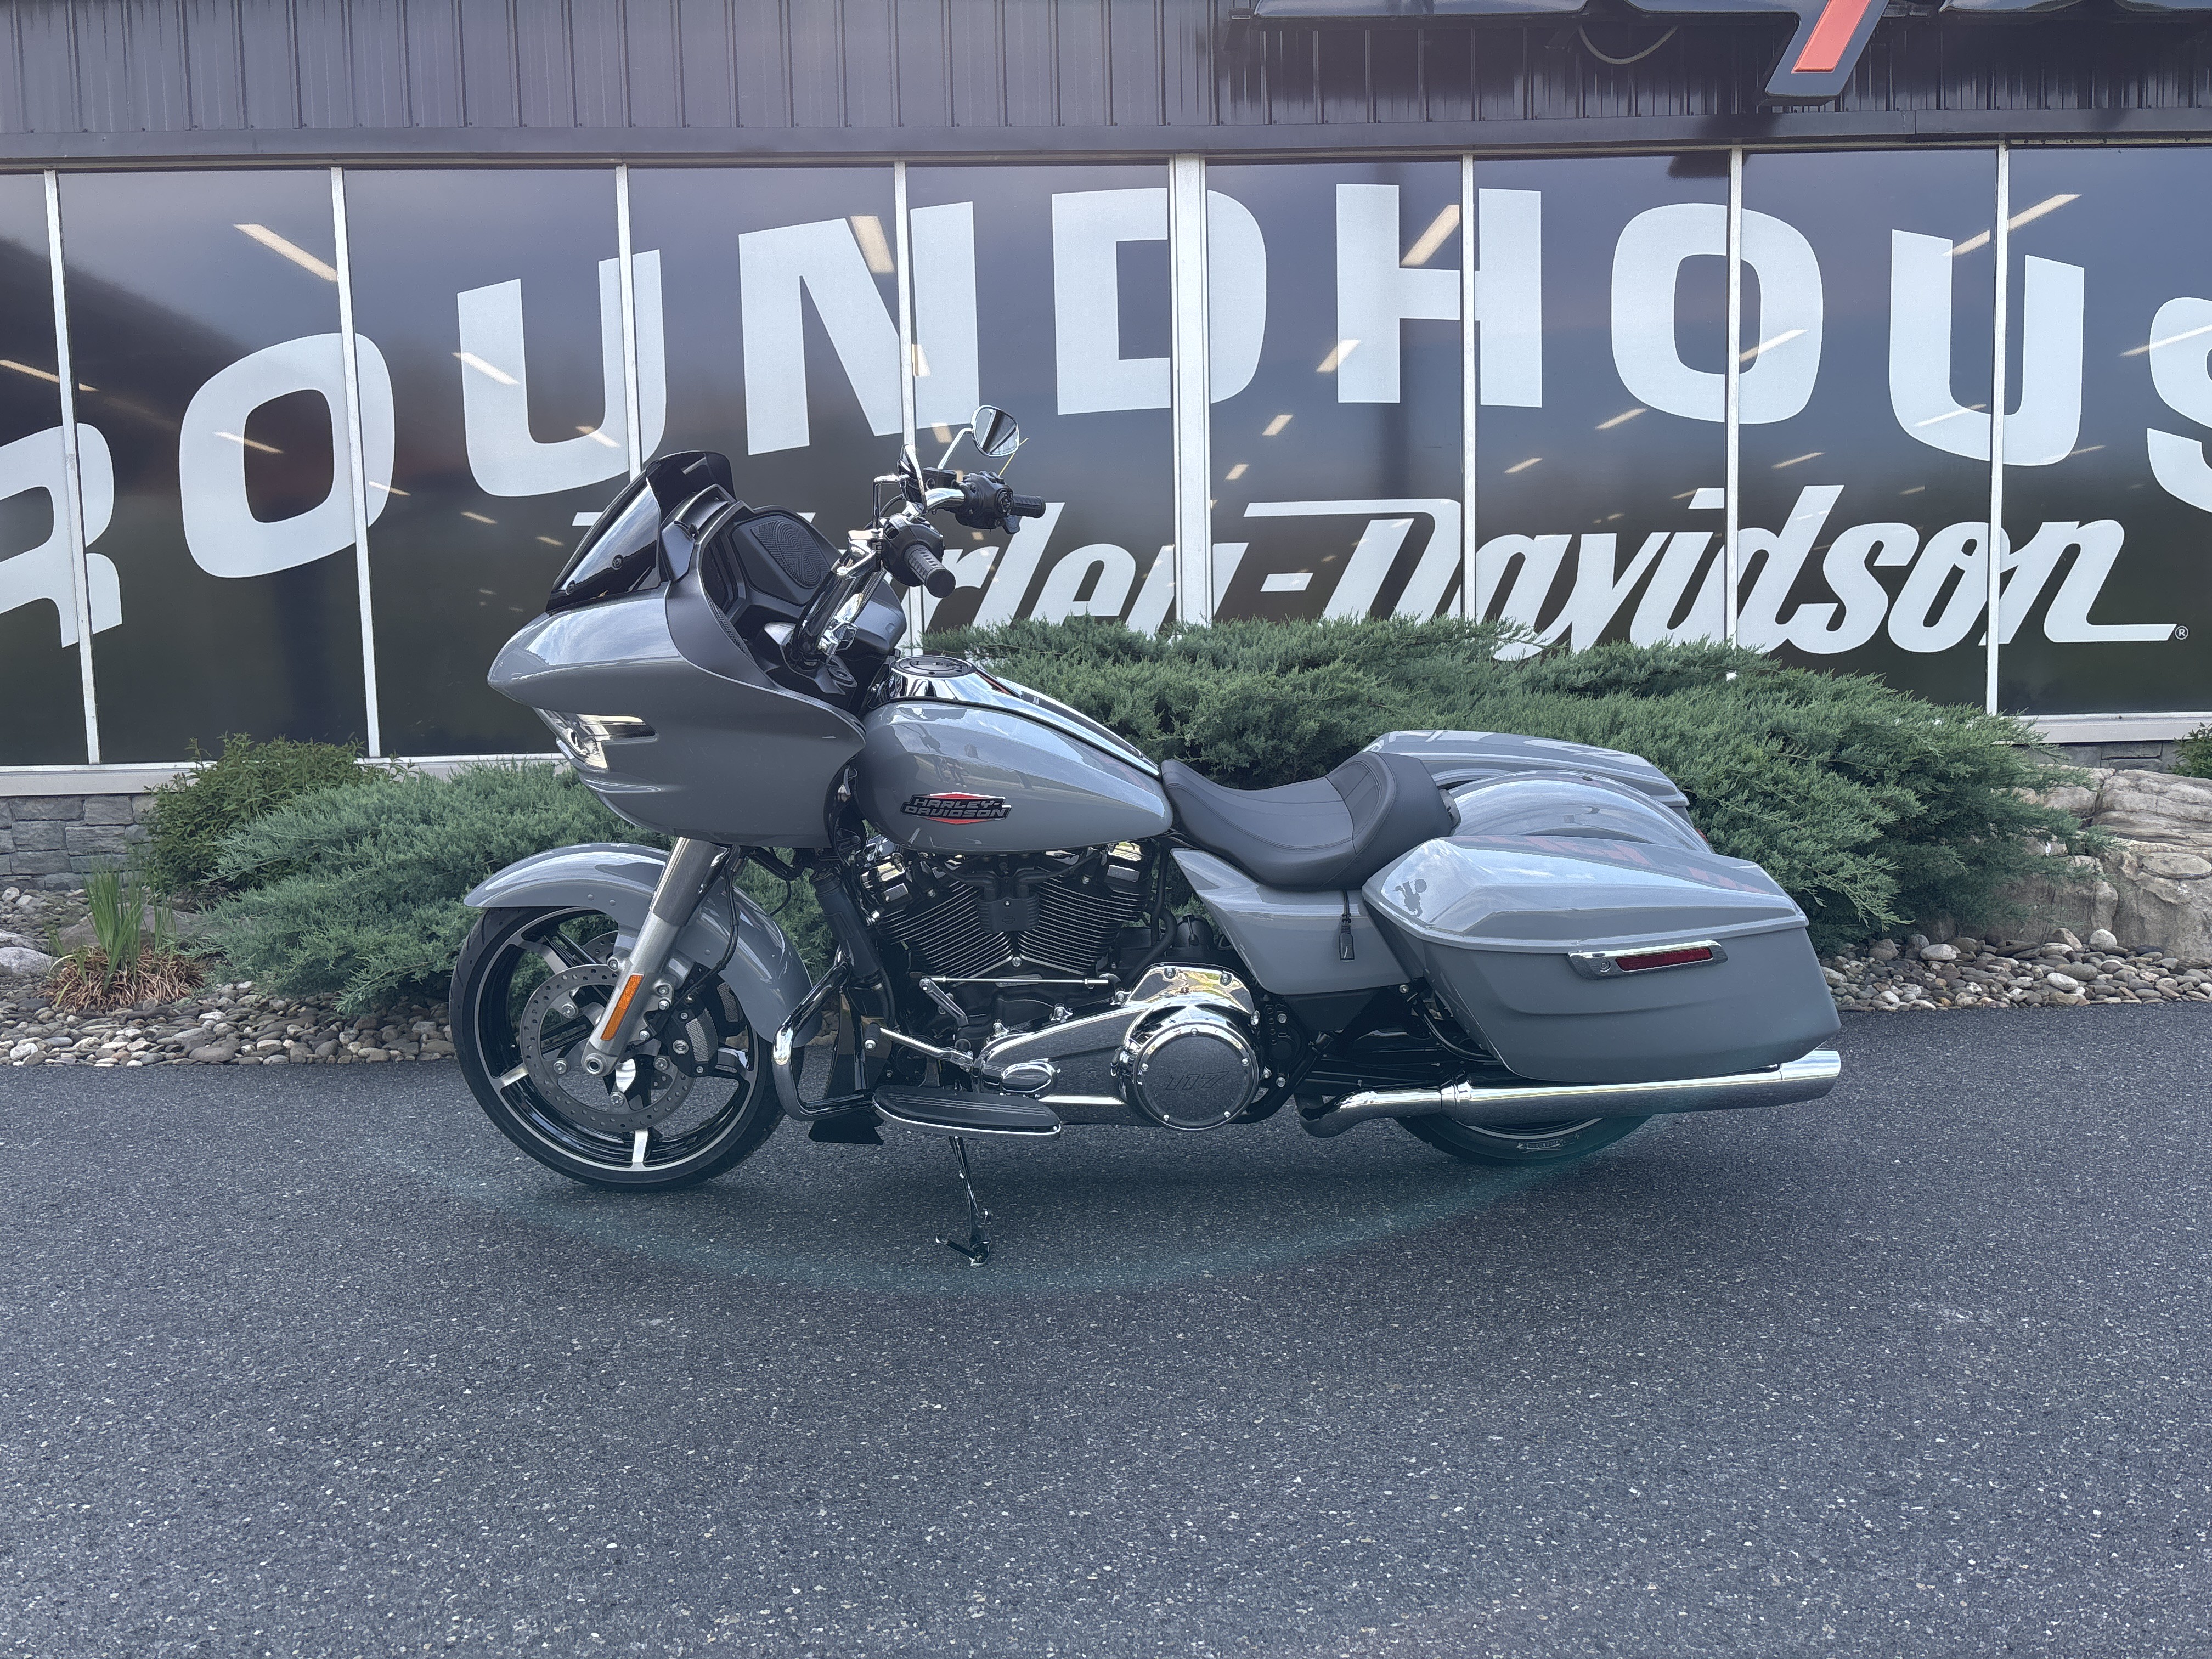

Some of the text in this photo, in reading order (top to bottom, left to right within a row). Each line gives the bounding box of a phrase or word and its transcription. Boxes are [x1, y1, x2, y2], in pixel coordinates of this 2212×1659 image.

[913, 798, 1000, 809] HARLEY-
[905, 805, 1006, 817] DAVIDSON
[1165, 1070, 1229, 1090] 117
